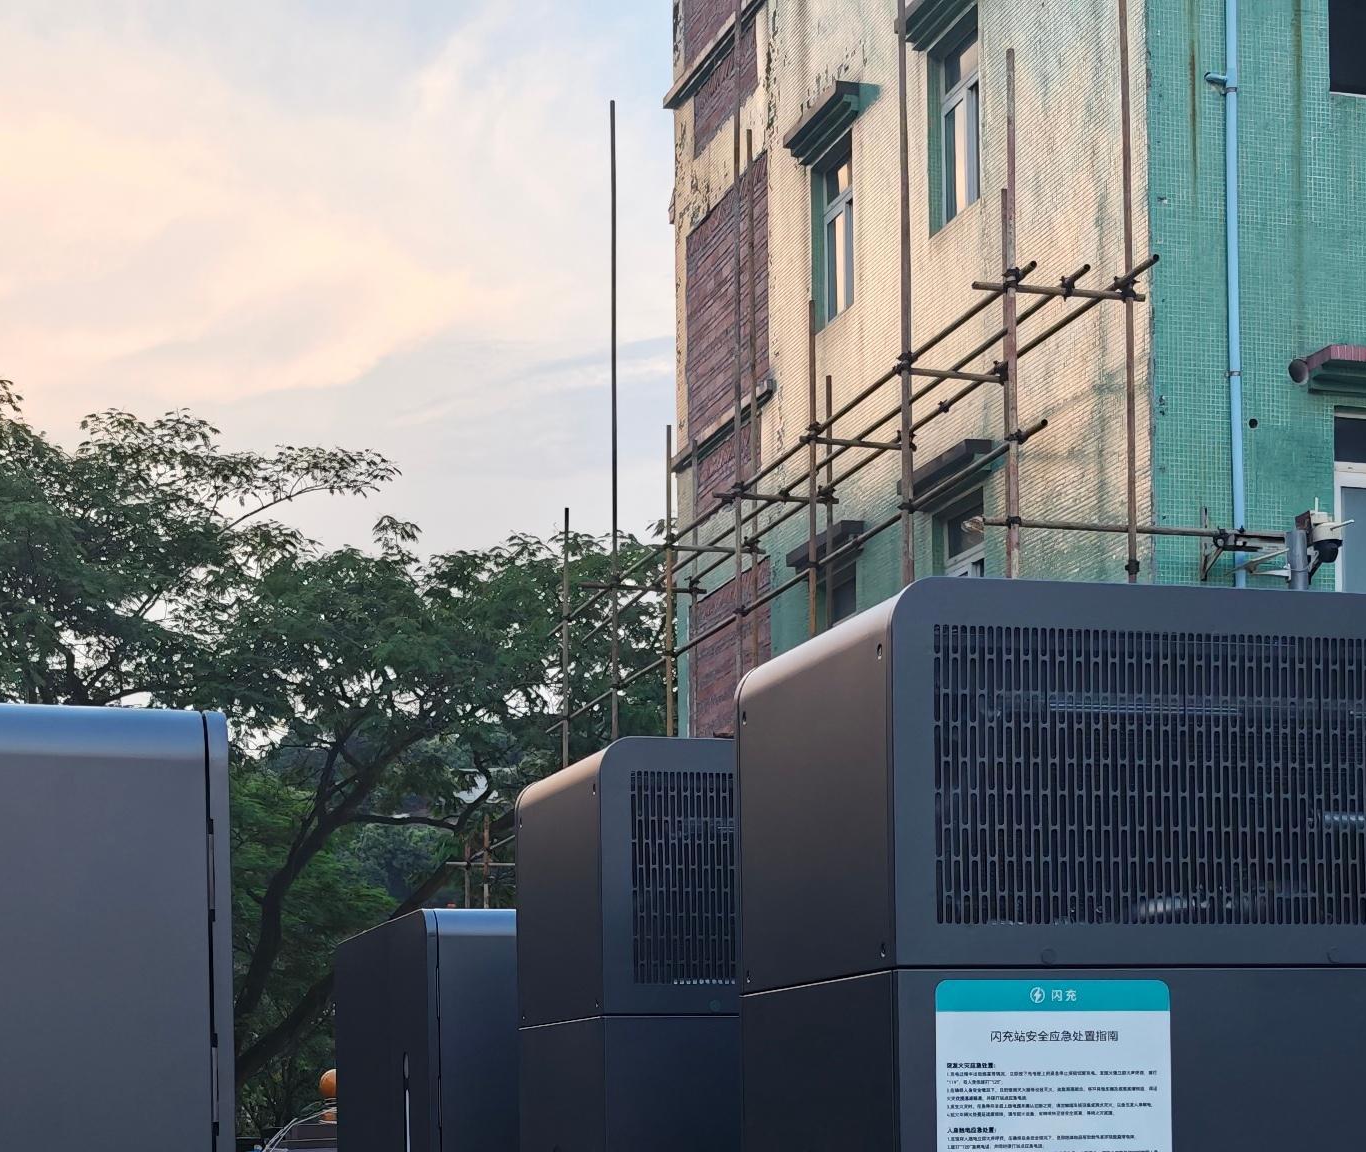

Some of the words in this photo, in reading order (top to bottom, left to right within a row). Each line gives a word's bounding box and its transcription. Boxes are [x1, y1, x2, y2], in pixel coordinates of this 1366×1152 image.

[1051, 989, 1077, 1002] 闪充
[990, 1030, 1119, 1043] 闪充站安全应急处置指南
